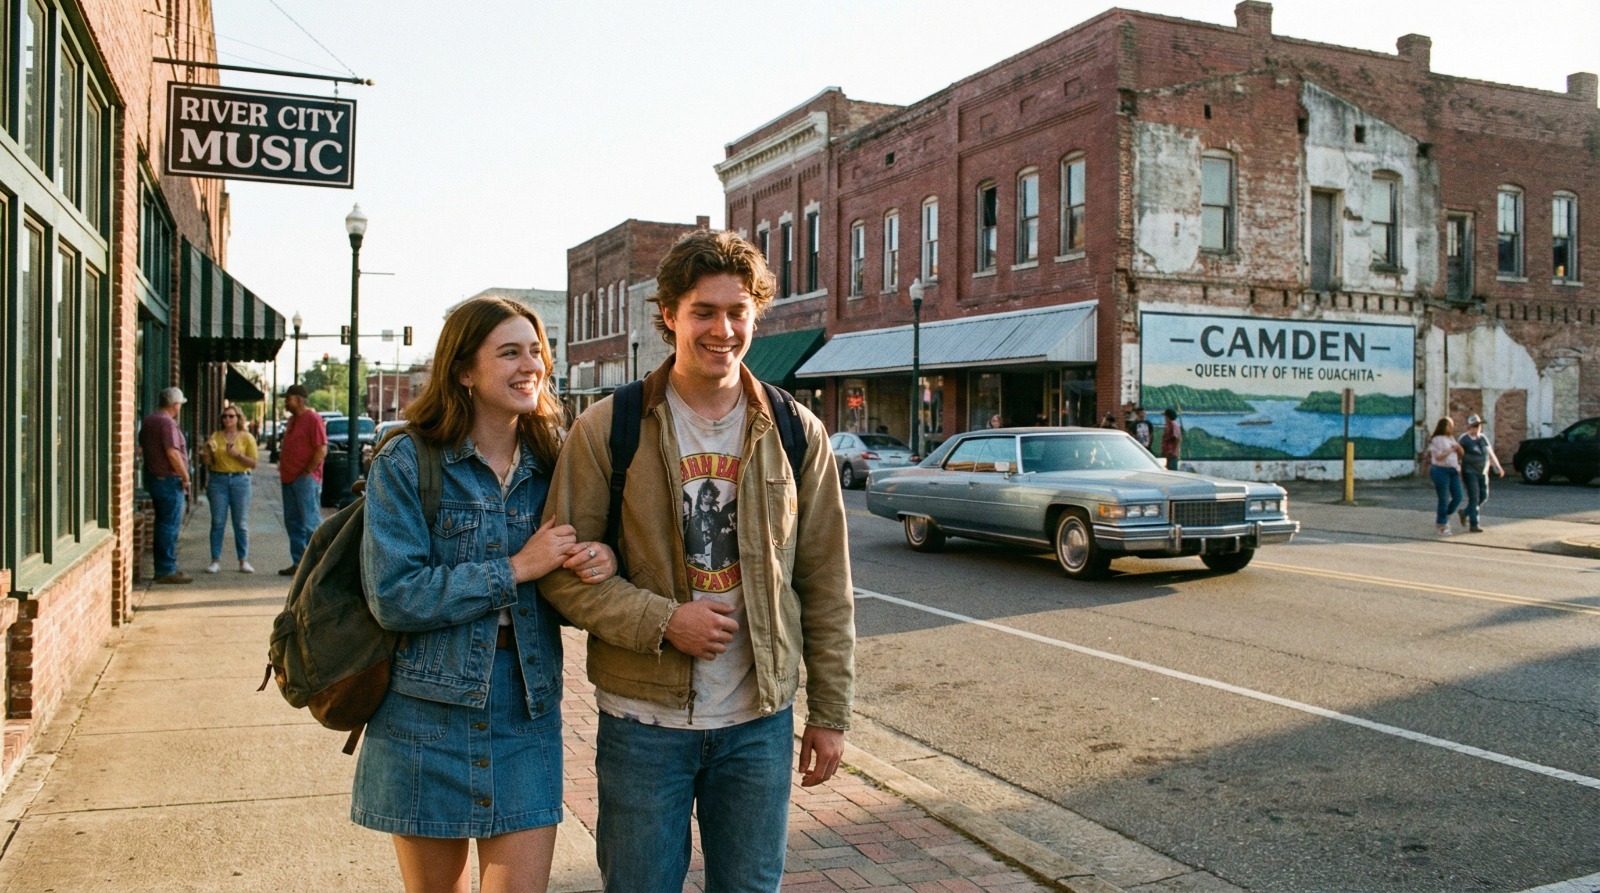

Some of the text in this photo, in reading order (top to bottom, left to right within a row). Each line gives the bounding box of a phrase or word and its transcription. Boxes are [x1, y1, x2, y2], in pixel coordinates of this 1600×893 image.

[180, 96, 345, 134] RIVER CITY
[179, 128, 343, 175] MUSIC
[1200, 325, 1365, 362] CAMDEN
[1194, 363, 1375, 382] QUEEN CITY OF THE OUACHITA
